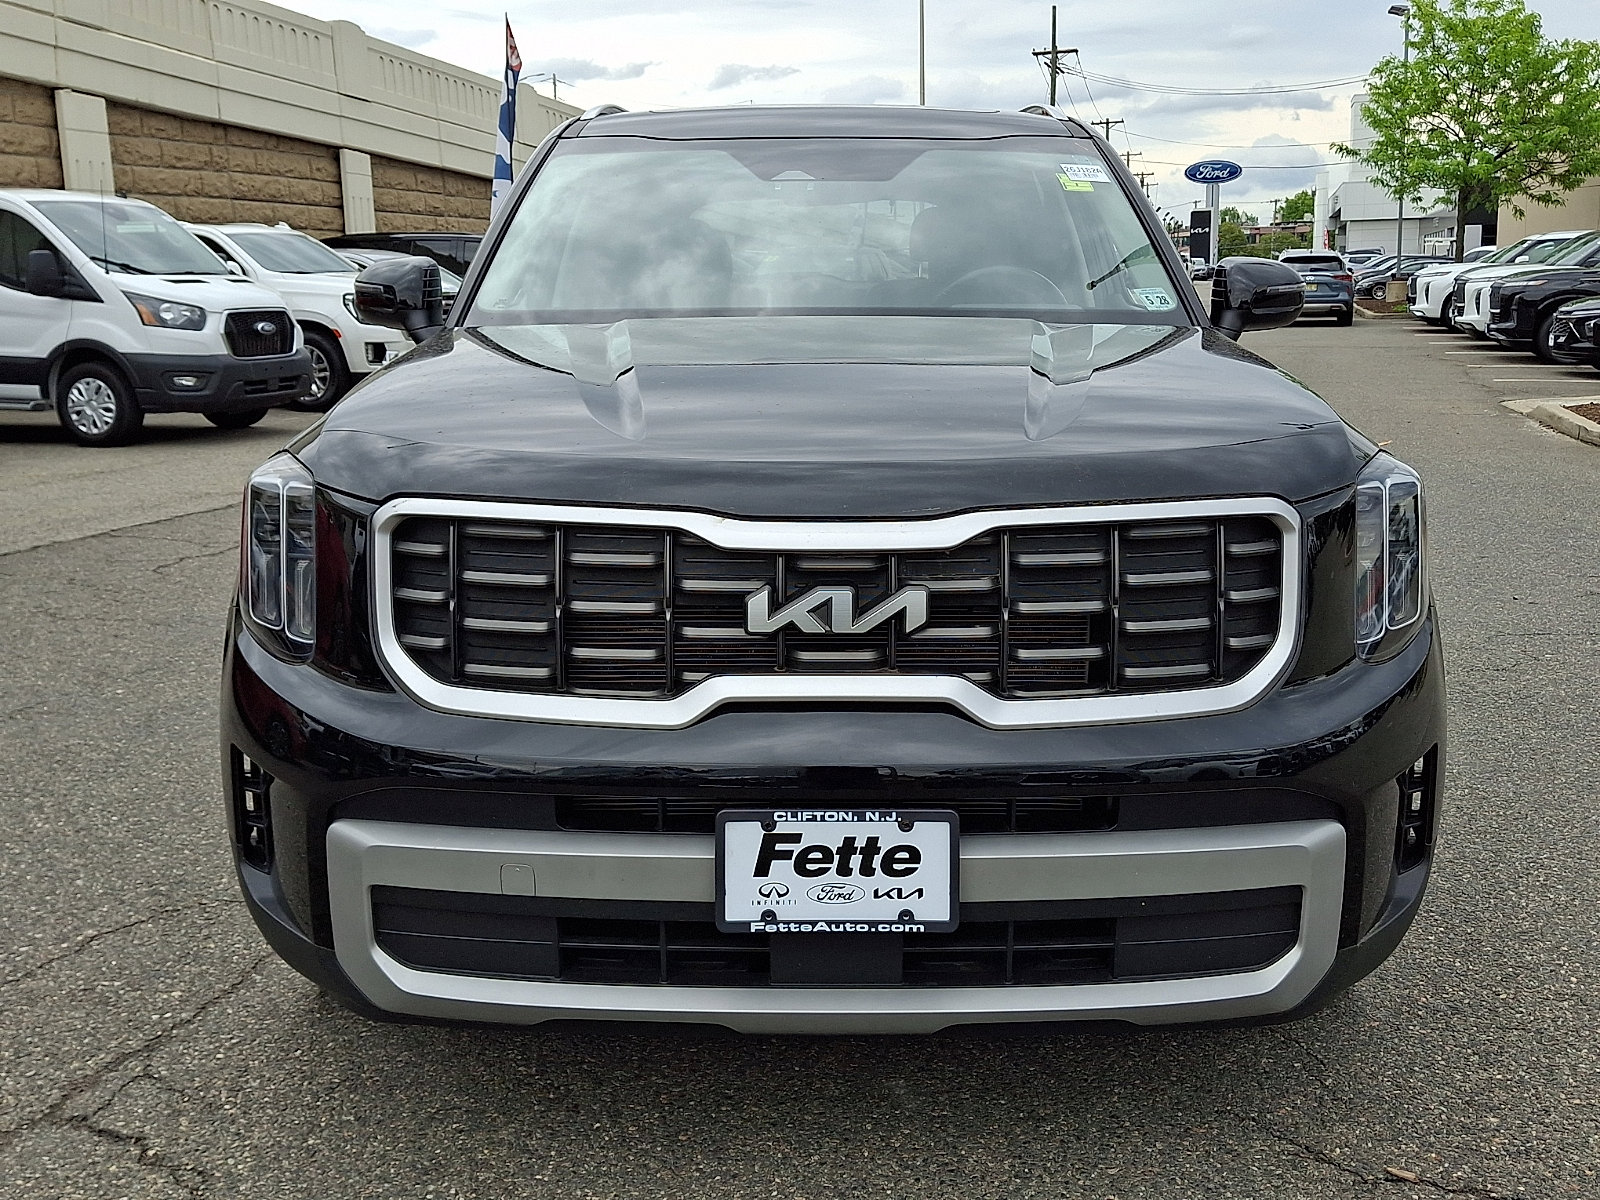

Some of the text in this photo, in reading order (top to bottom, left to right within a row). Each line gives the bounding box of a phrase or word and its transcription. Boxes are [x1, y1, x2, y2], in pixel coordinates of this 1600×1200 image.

[1196, 164, 1230, 179] Ford
[1144, 295, 1170, 305] 5 28
[745, 584, 929, 634] KIA
[773, 811, 902, 822] CLIFTON, N.J.
[752, 832, 922, 878] Fette
[816, 885, 855, 902] Ford
[872, 887, 925, 900] KIA
[750, 921, 925, 933] FetteAuto.com
